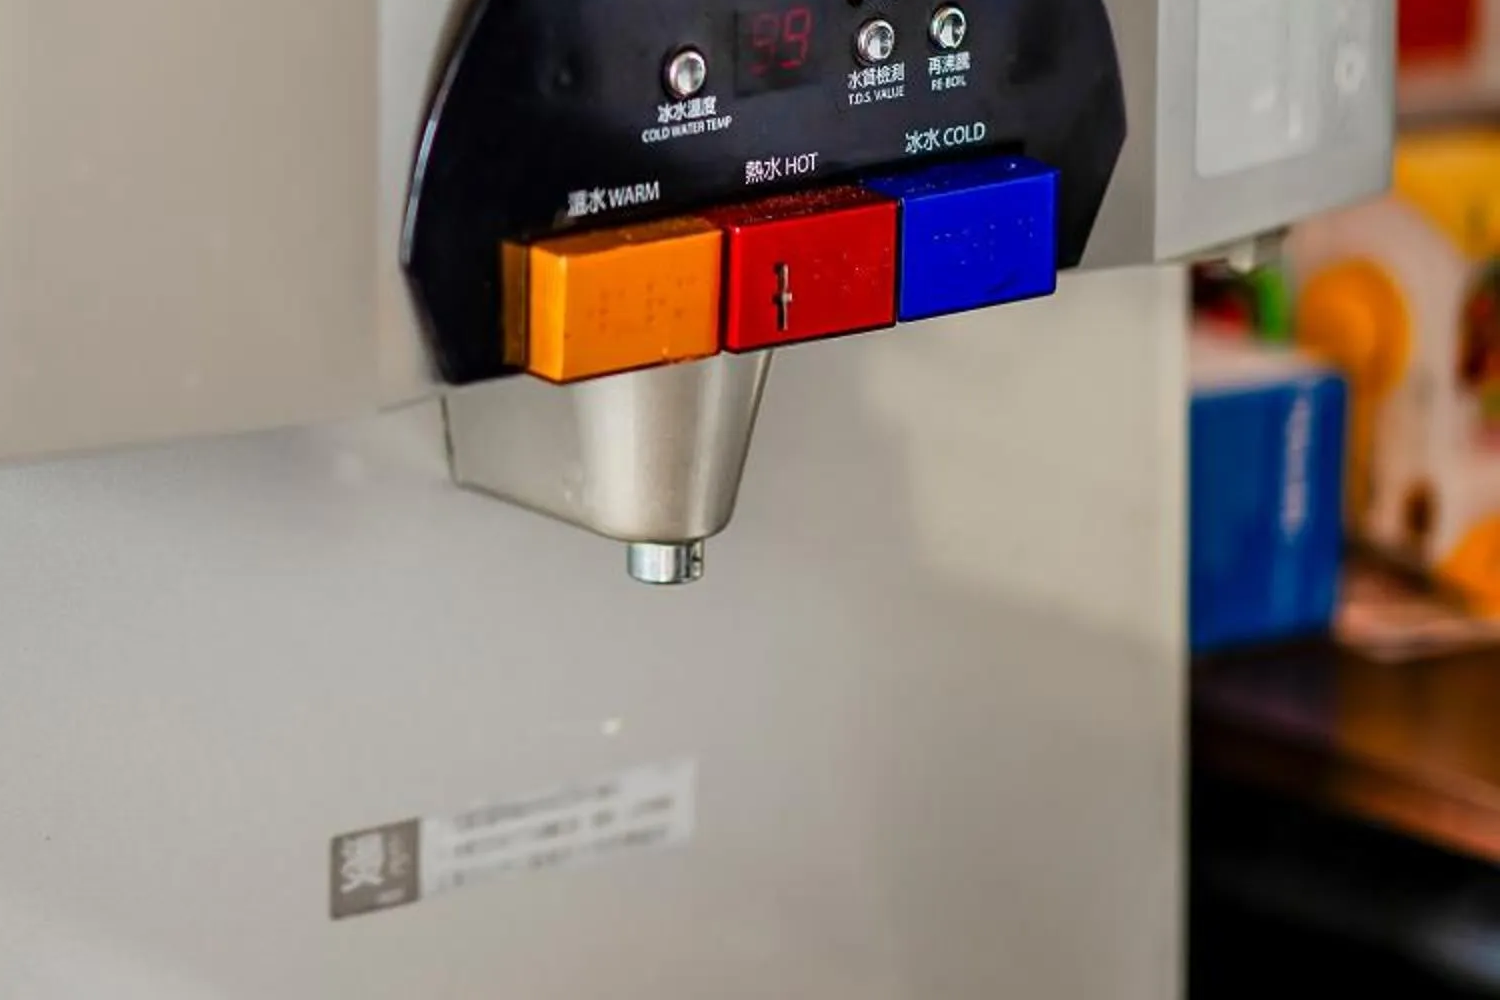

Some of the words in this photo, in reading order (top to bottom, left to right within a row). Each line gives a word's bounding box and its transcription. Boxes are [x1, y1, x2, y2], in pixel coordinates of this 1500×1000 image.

[873, 84, 906, 101] VALUE
[642, 126, 670, 143] COLD
[671, 119, 705, 137] WATER
[706, 115, 733, 132] TEMP
[943, 122, 986, 147] COLD
[785, 152, 818, 176] HOT
[608, 181, 660, 208] WARM
